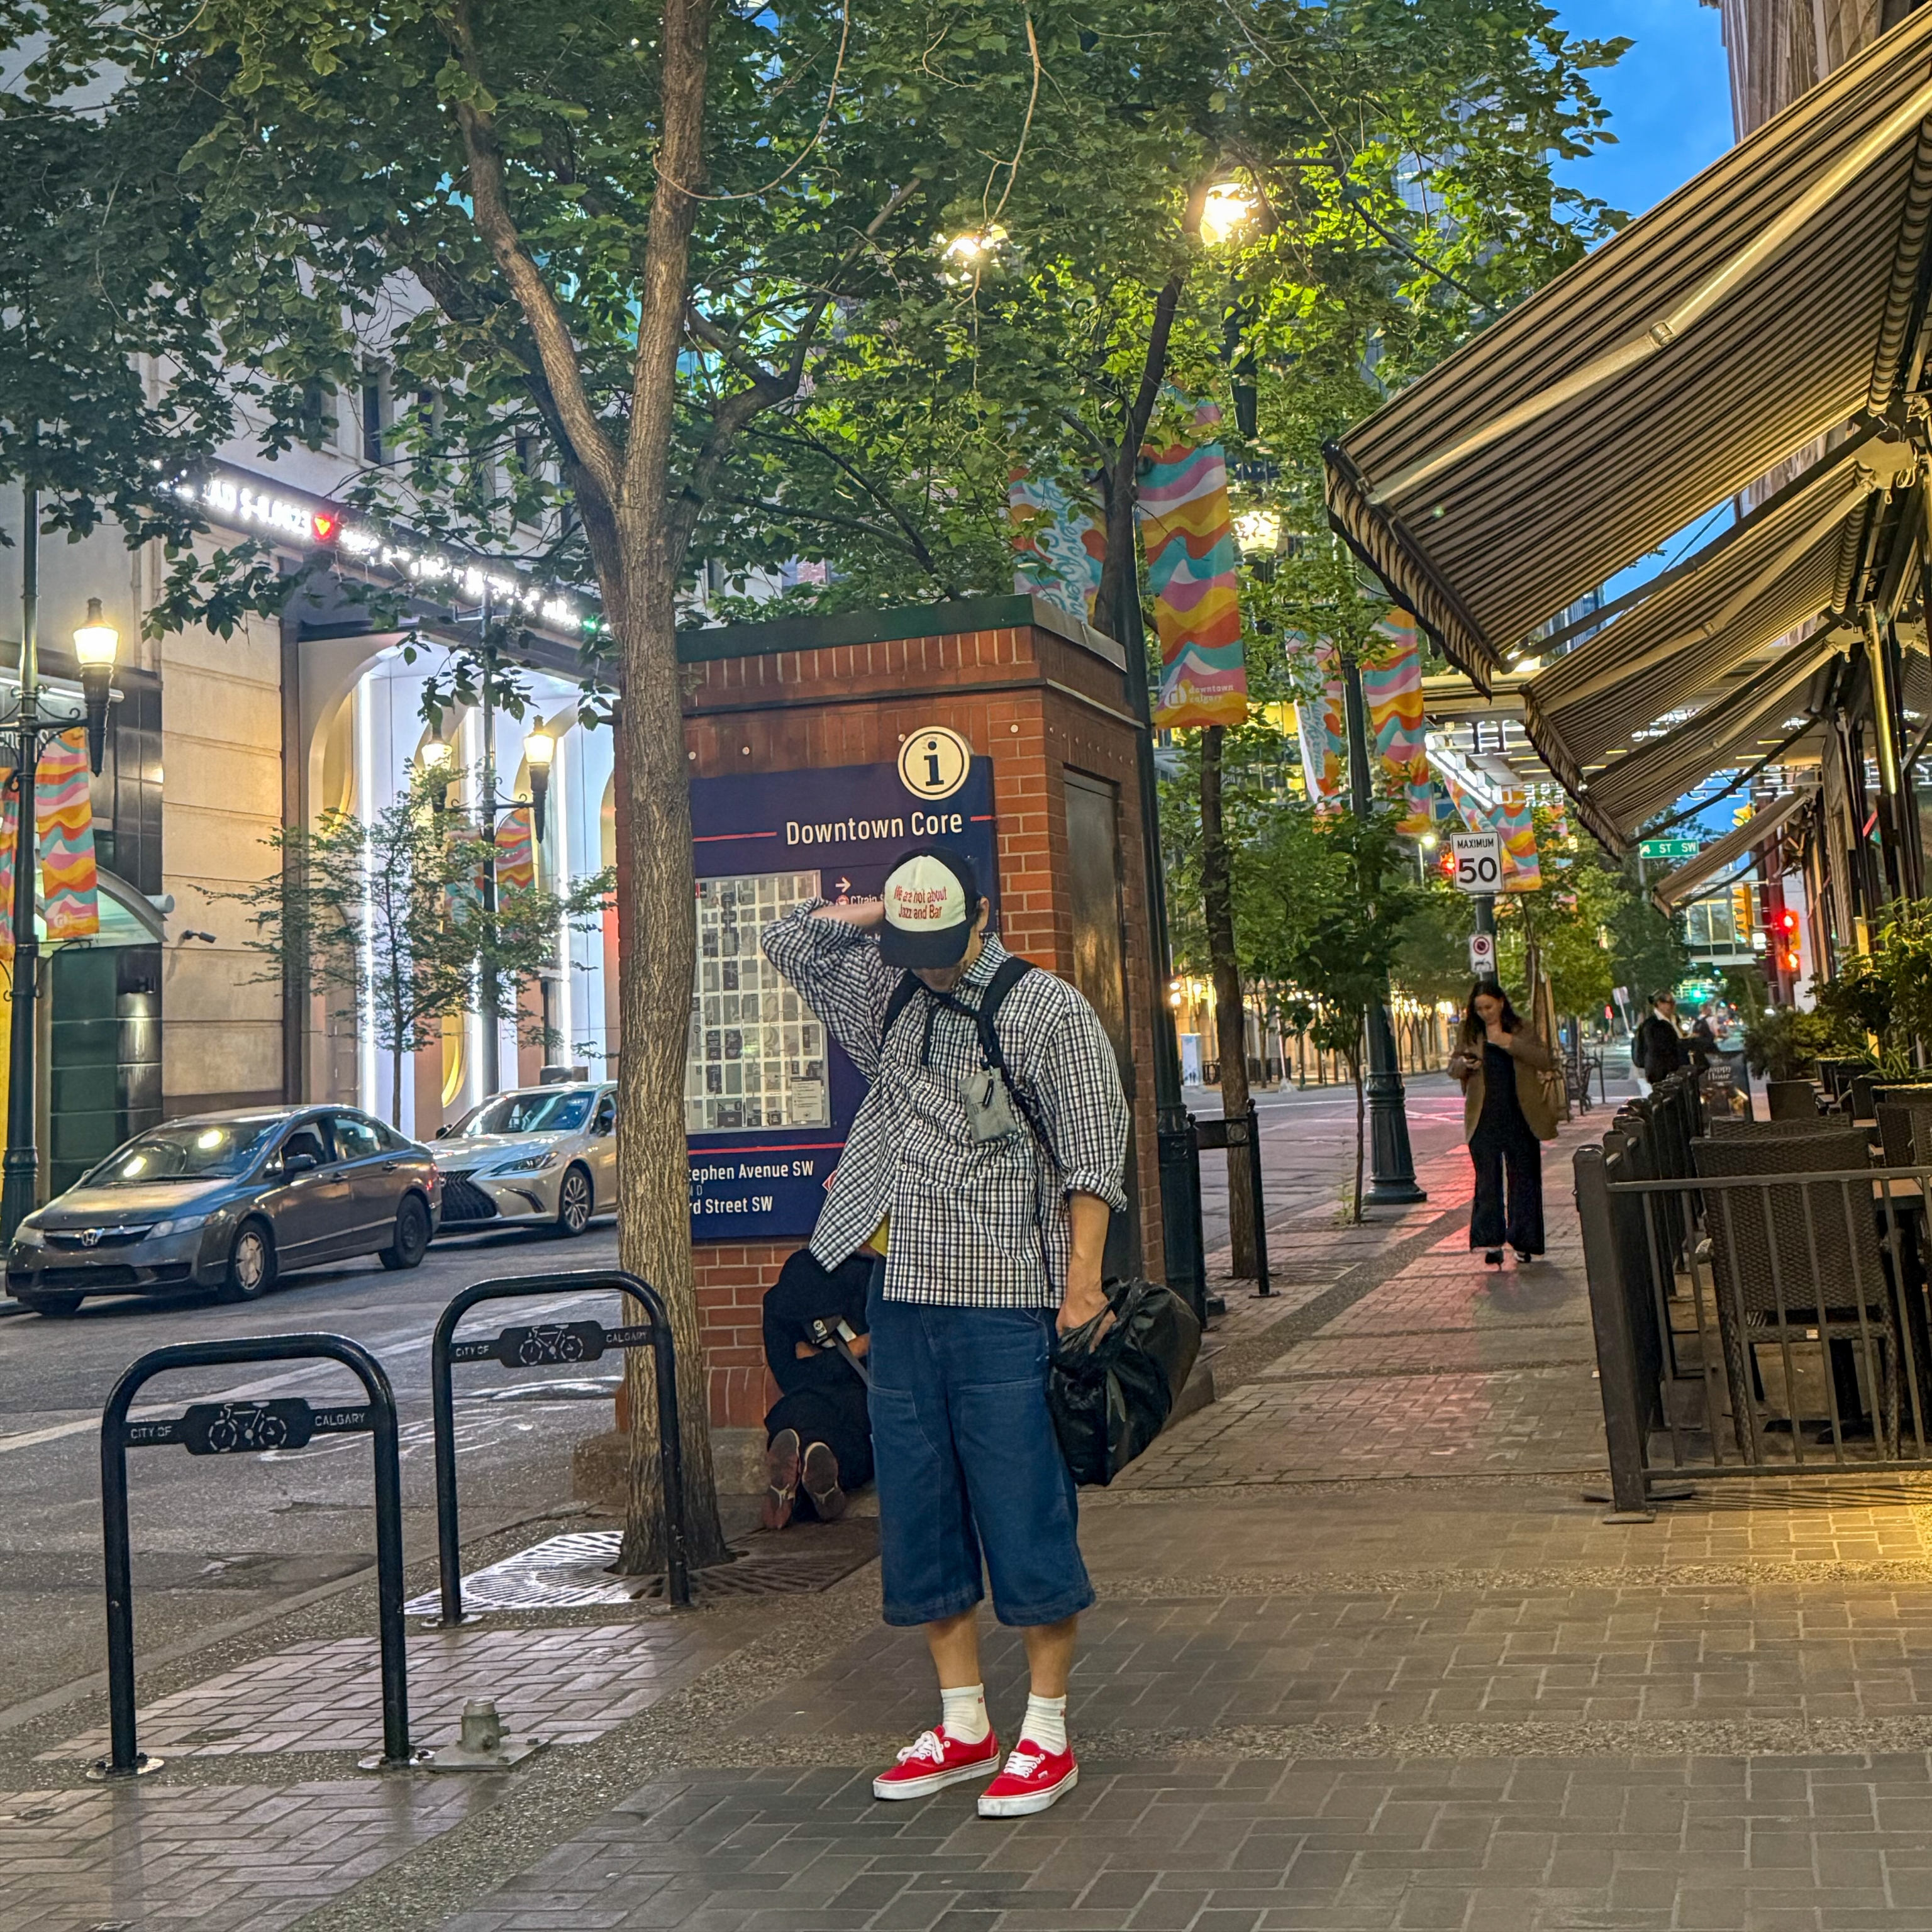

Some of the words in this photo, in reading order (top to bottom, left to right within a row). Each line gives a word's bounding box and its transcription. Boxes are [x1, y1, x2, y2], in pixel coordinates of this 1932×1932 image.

[1189, 684, 1234, 693] downtown
[786, 818, 904, 845] Downtown
[911, 811, 962, 836] Core
[1457, 838, 1494, 848] MAXIMUM
[1659, 843, 1672, 854] ST
[1681, 842, 1696, 853] SW
[1459, 857, 1497, 884] 50
[914, 889, 926, 904] not
[927, 886, 947, 903] about
[899, 903, 912, 919] Jazz
[914, 904, 927, 919] and
[930, 904, 942, 919] Bar
[689, 1164, 735, 1185] ephen
[738, 1163, 789, 1179] Avenue
[792, 1160, 814, 1177] SW
[705, 1197, 748, 1214] Street
[752, 1196, 773, 1212] SW
[456, 1346, 475, 1357] CITY
[606, 1331, 648, 1343] CALGARY
[130, 1428, 153, 1439] CITY
[158, 1426, 172, 1437] OF
[315, 1413, 365, 1426] CALGARY
